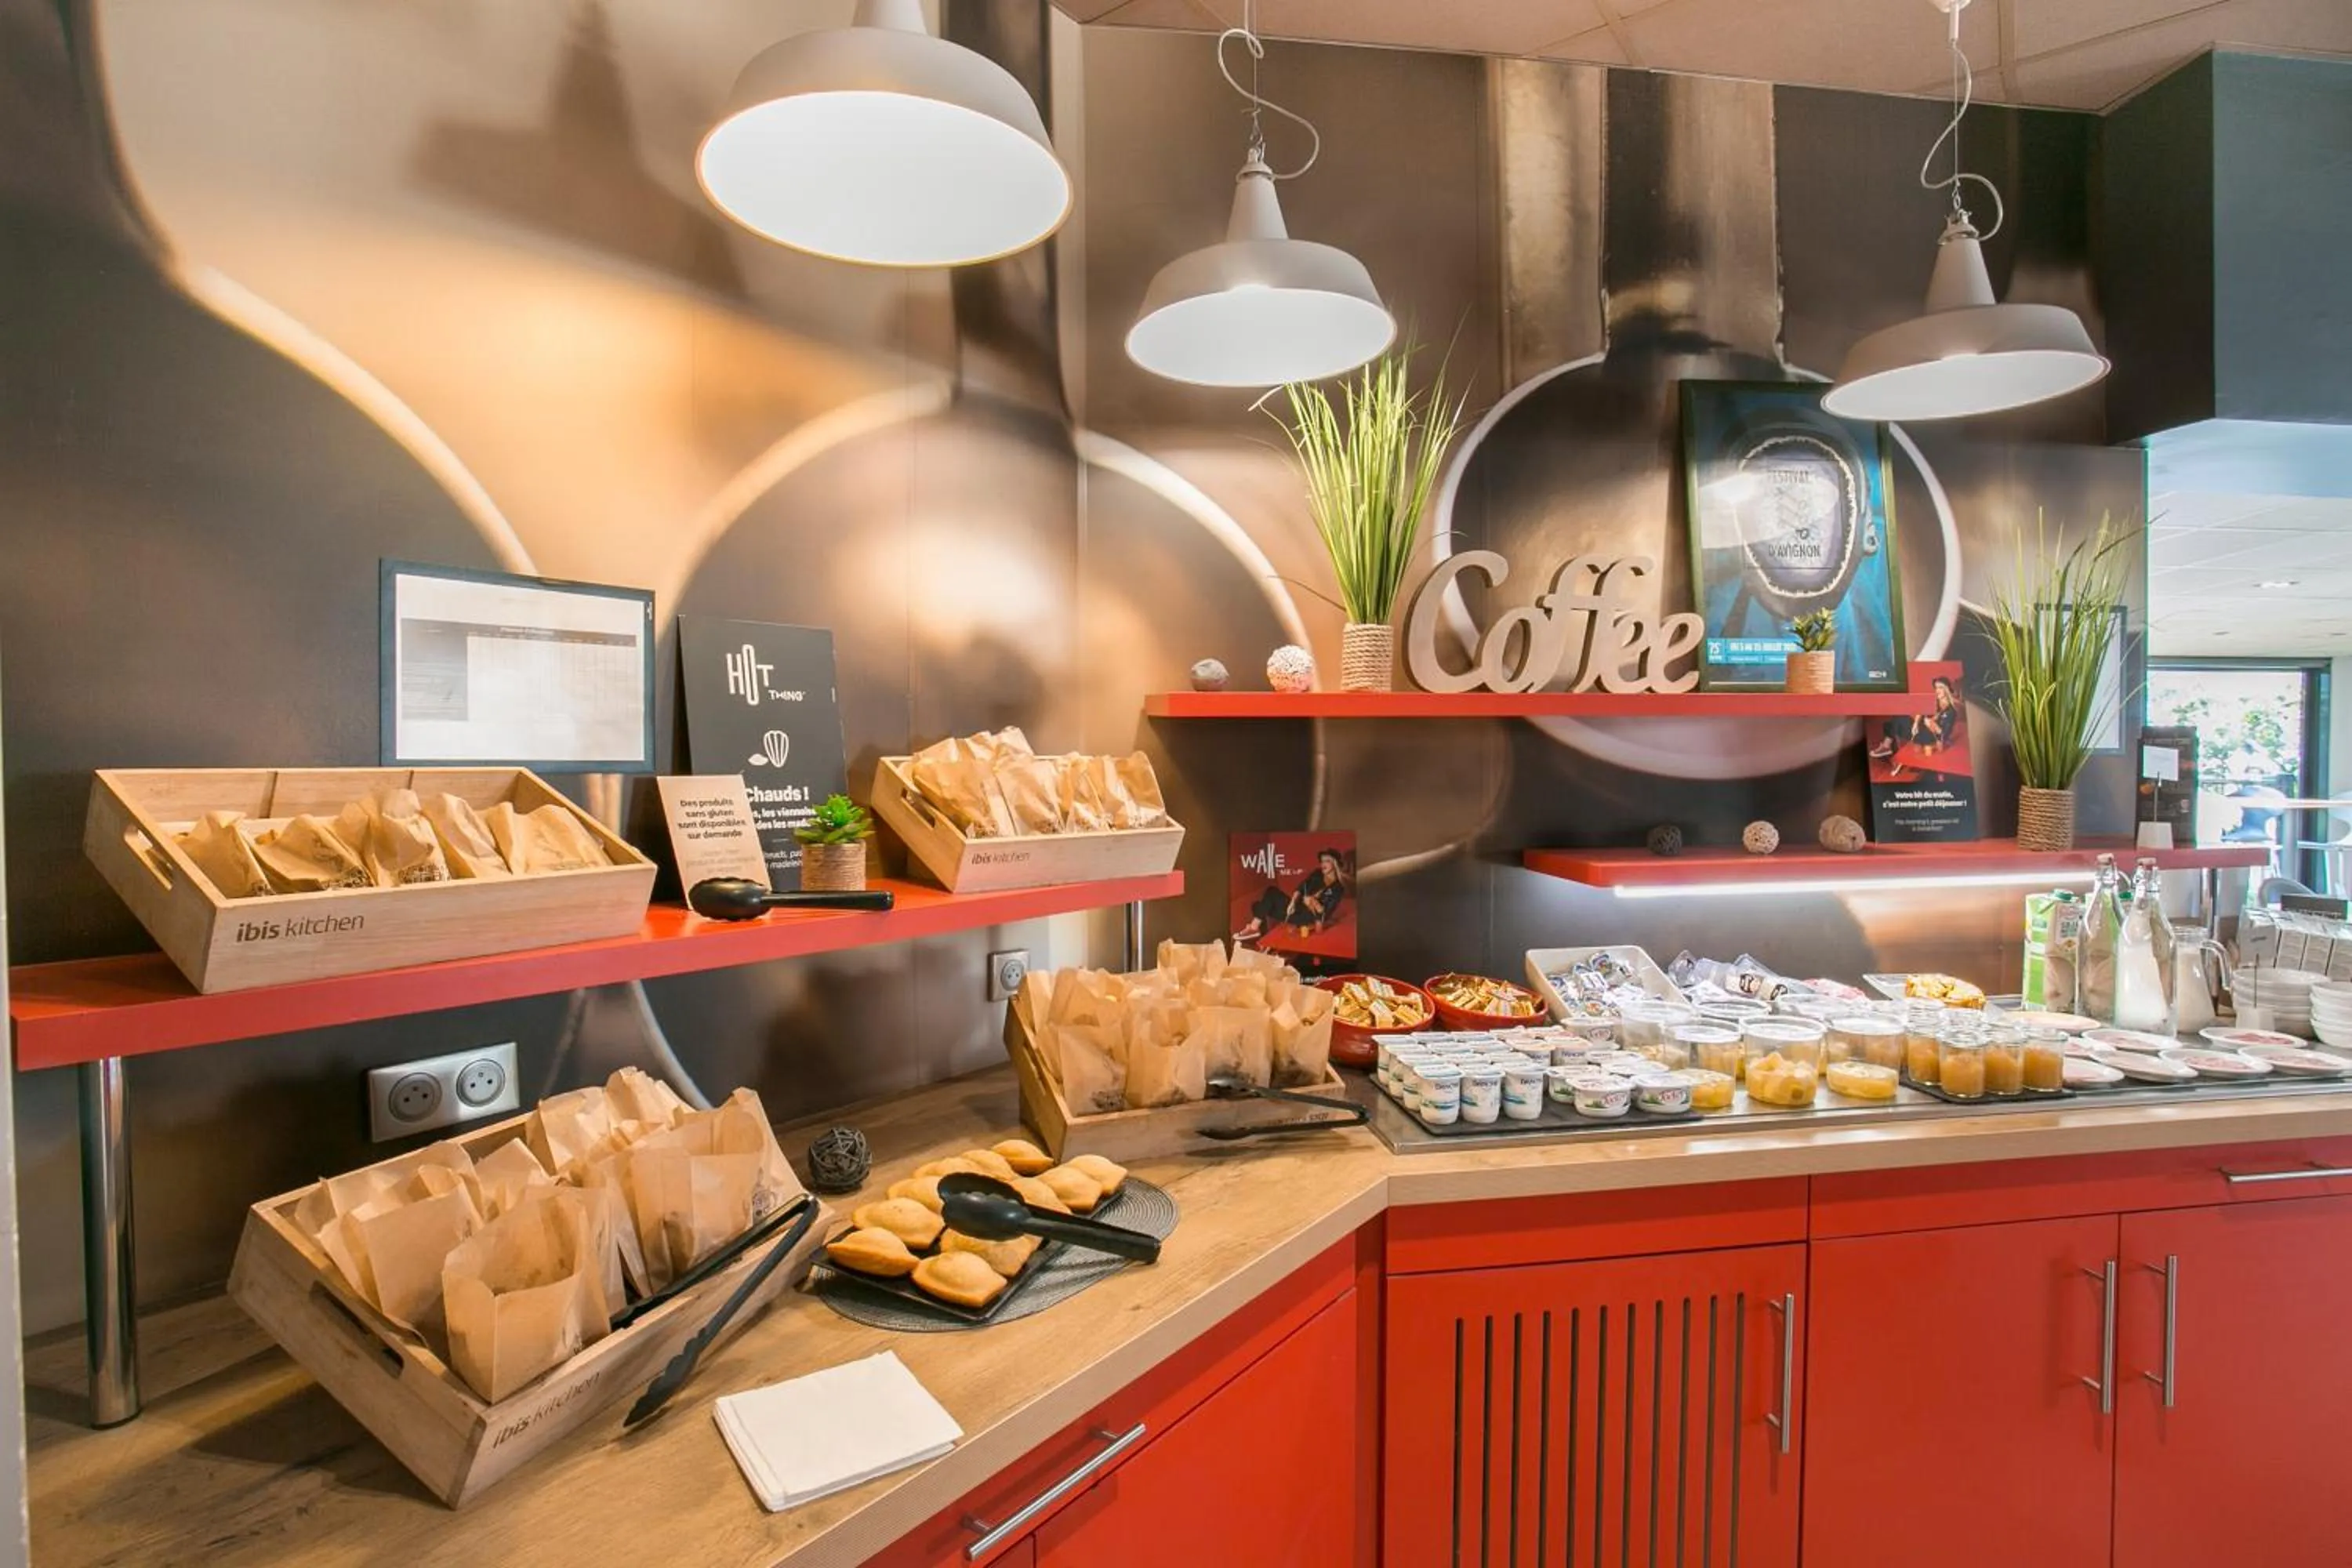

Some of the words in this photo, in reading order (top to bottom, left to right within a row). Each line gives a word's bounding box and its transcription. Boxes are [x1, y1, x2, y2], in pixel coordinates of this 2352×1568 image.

[1402, 550, 1704, 695] Coffee
[726, 644, 774, 706] HOT
[745, 785, 802, 802] Chauds
[971, 851, 991, 865] ibis
[992, 851, 1030, 864] kitchen
[1240, 843, 1286, 879] WAKE
[236, 920, 281, 942] ibis
[285, 914, 365, 937] kitchen
[492, 1414, 531, 1449] ibis
